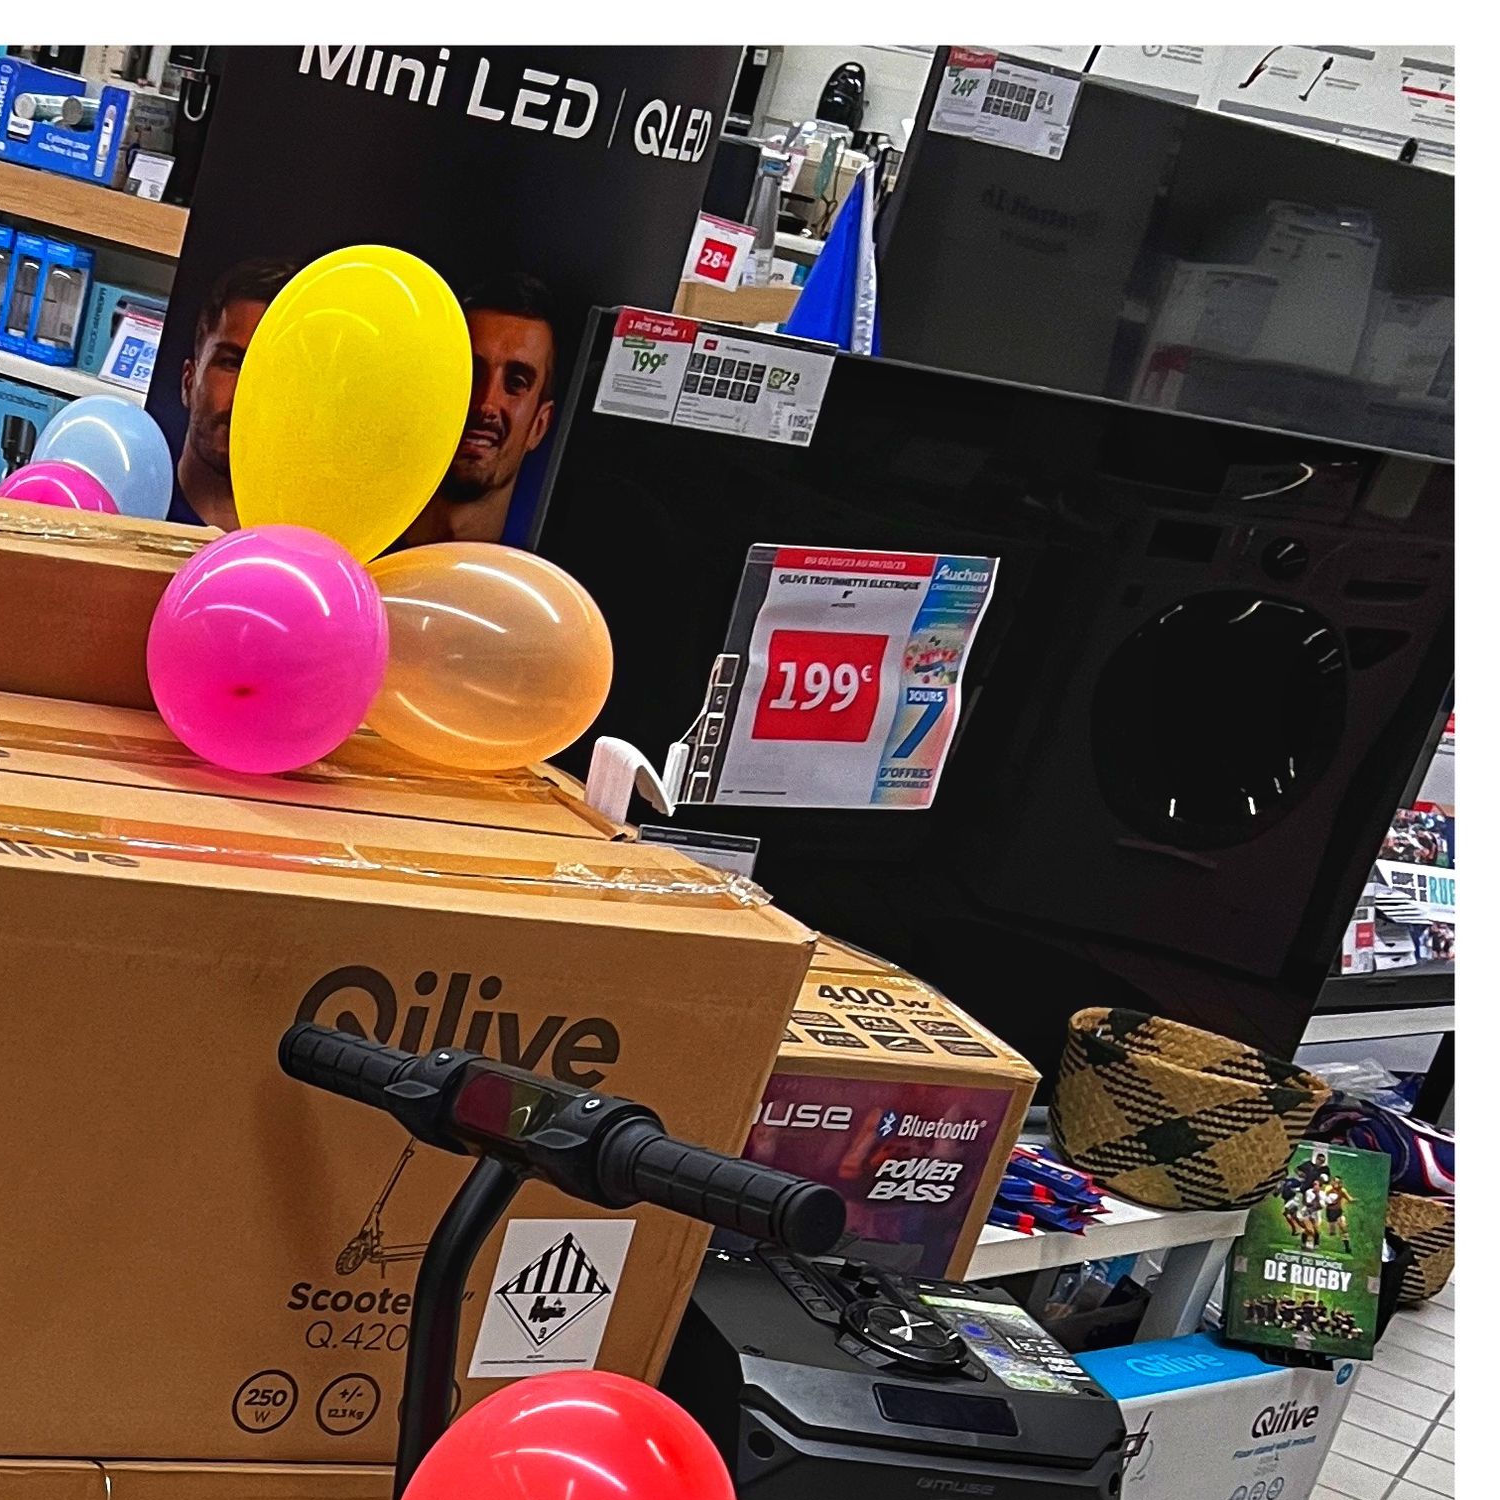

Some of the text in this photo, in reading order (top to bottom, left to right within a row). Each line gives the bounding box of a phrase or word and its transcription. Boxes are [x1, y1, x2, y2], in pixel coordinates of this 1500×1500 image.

[299, 45, 713, 163] Mini LED QLED
[935, 564, 988, 583] Auchan
[768, 661, 873, 713] 199€
[908, 689, 944, 703] JOURS
[890, 687, 949, 759] 7
[880, 767, 932, 780] D'OFFRES
[817, 984, 895, 1007] 400
[295, 965, 621, 1089] Qilive
[875, 1157, 964, 1182] POWER
[867, 1179, 955, 1203] BASS
[1263, 1259, 1353, 1293] DE RUGBY
[286, 1282, 412, 1316] Scoote
[305, 1320, 409, 1353] Q.420
[1126, 1352, 1226, 1378] Qilive
[244, 1387, 287, 1407] 250
[252, 1409, 271, 1425] W
[1251, 1399, 1320, 1440] Qilive
